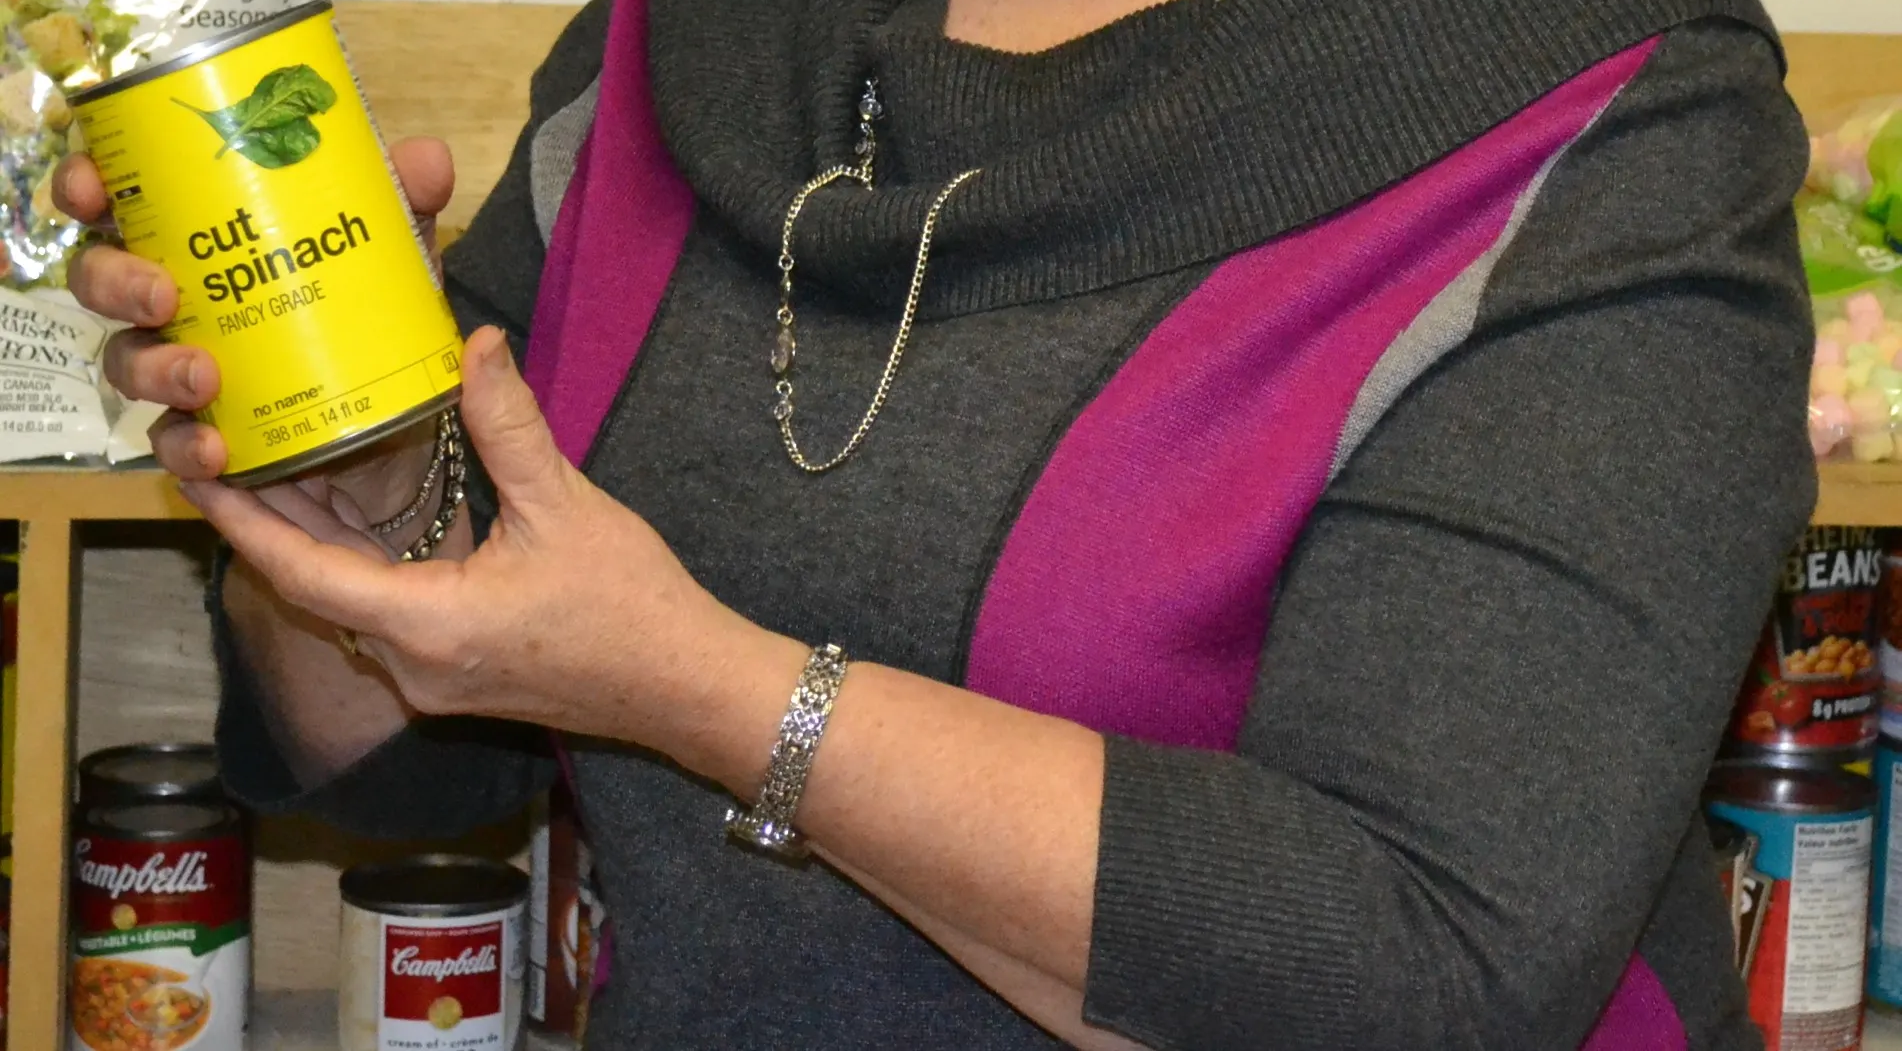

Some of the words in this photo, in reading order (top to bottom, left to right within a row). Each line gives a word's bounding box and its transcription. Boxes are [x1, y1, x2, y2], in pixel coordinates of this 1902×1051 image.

[179, 4, 284, 28] Season
[188, 207, 260, 260] cut
[203, 212, 371, 304] spinach
[217, 304, 266, 336] FANCY
[268, 280, 326, 317] GRADE
[3, 379, 52, 391] CANADA
[253, 404, 272, 419] no
[262, 424, 291, 448] 398
[293, 415, 318, 438] mL
[319, 407, 338, 427] 14
[340, 401, 352, 418] fl
[354, 396, 372, 414] oz
[1783, 548, 1882, 591] BEANS
